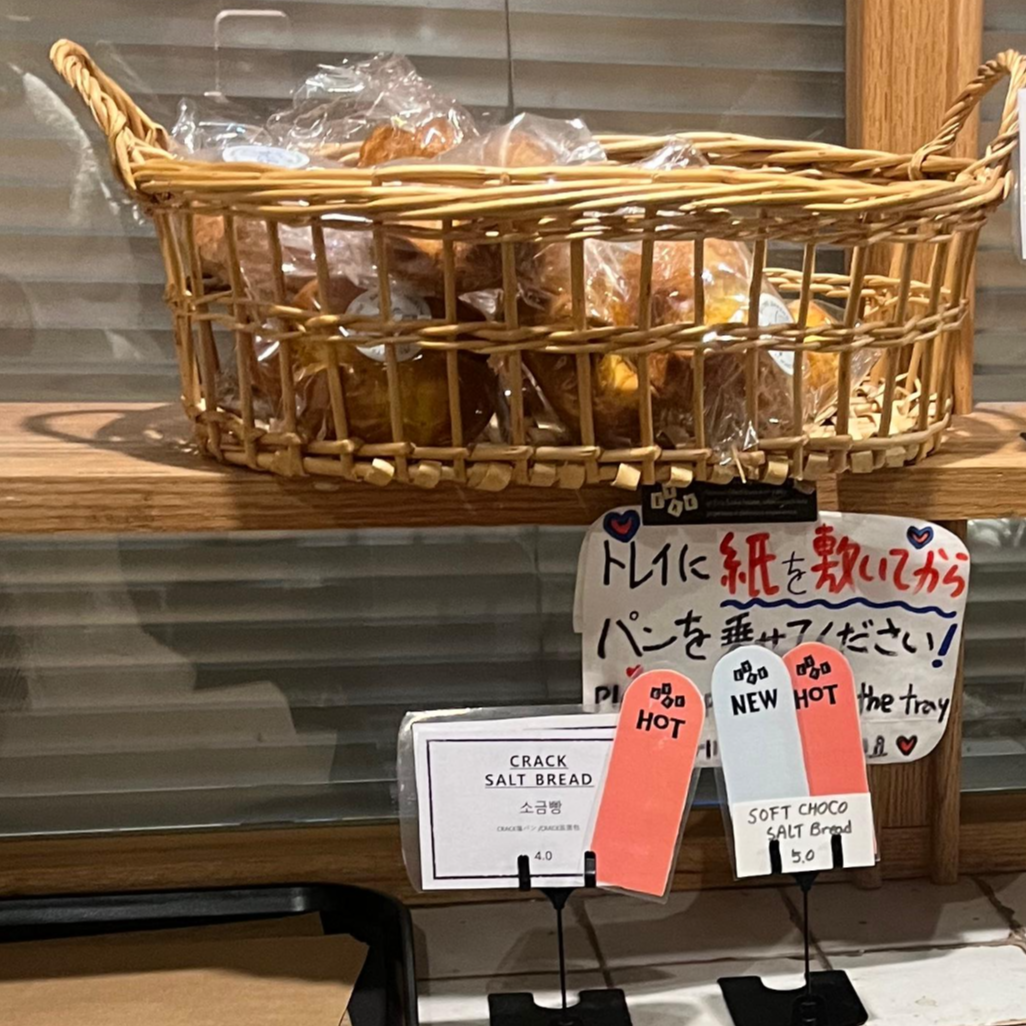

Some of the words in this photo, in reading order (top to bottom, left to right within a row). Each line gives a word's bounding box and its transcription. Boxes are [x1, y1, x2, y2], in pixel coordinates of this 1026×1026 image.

[730, 688, 778, 716] NEW
[793, 684, 838, 710] HOT
[899, 683, 950, 723] tray
[636, 709, 686, 739] HOT
[509, 755, 568, 768] CRACK
[484, 774, 526, 787] SALT
[535, 773, 593, 786] BREAD
[519, 800, 562, 815] 소금빵
[748, 804, 792, 824] SOFT
[799, 800, 848, 816] CHOCO
[766, 823, 804, 841] SALT
[810, 820, 852, 837] Bread
[534, 850, 553, 861] 4.0
[791, 849, 815, 864] 5.0
